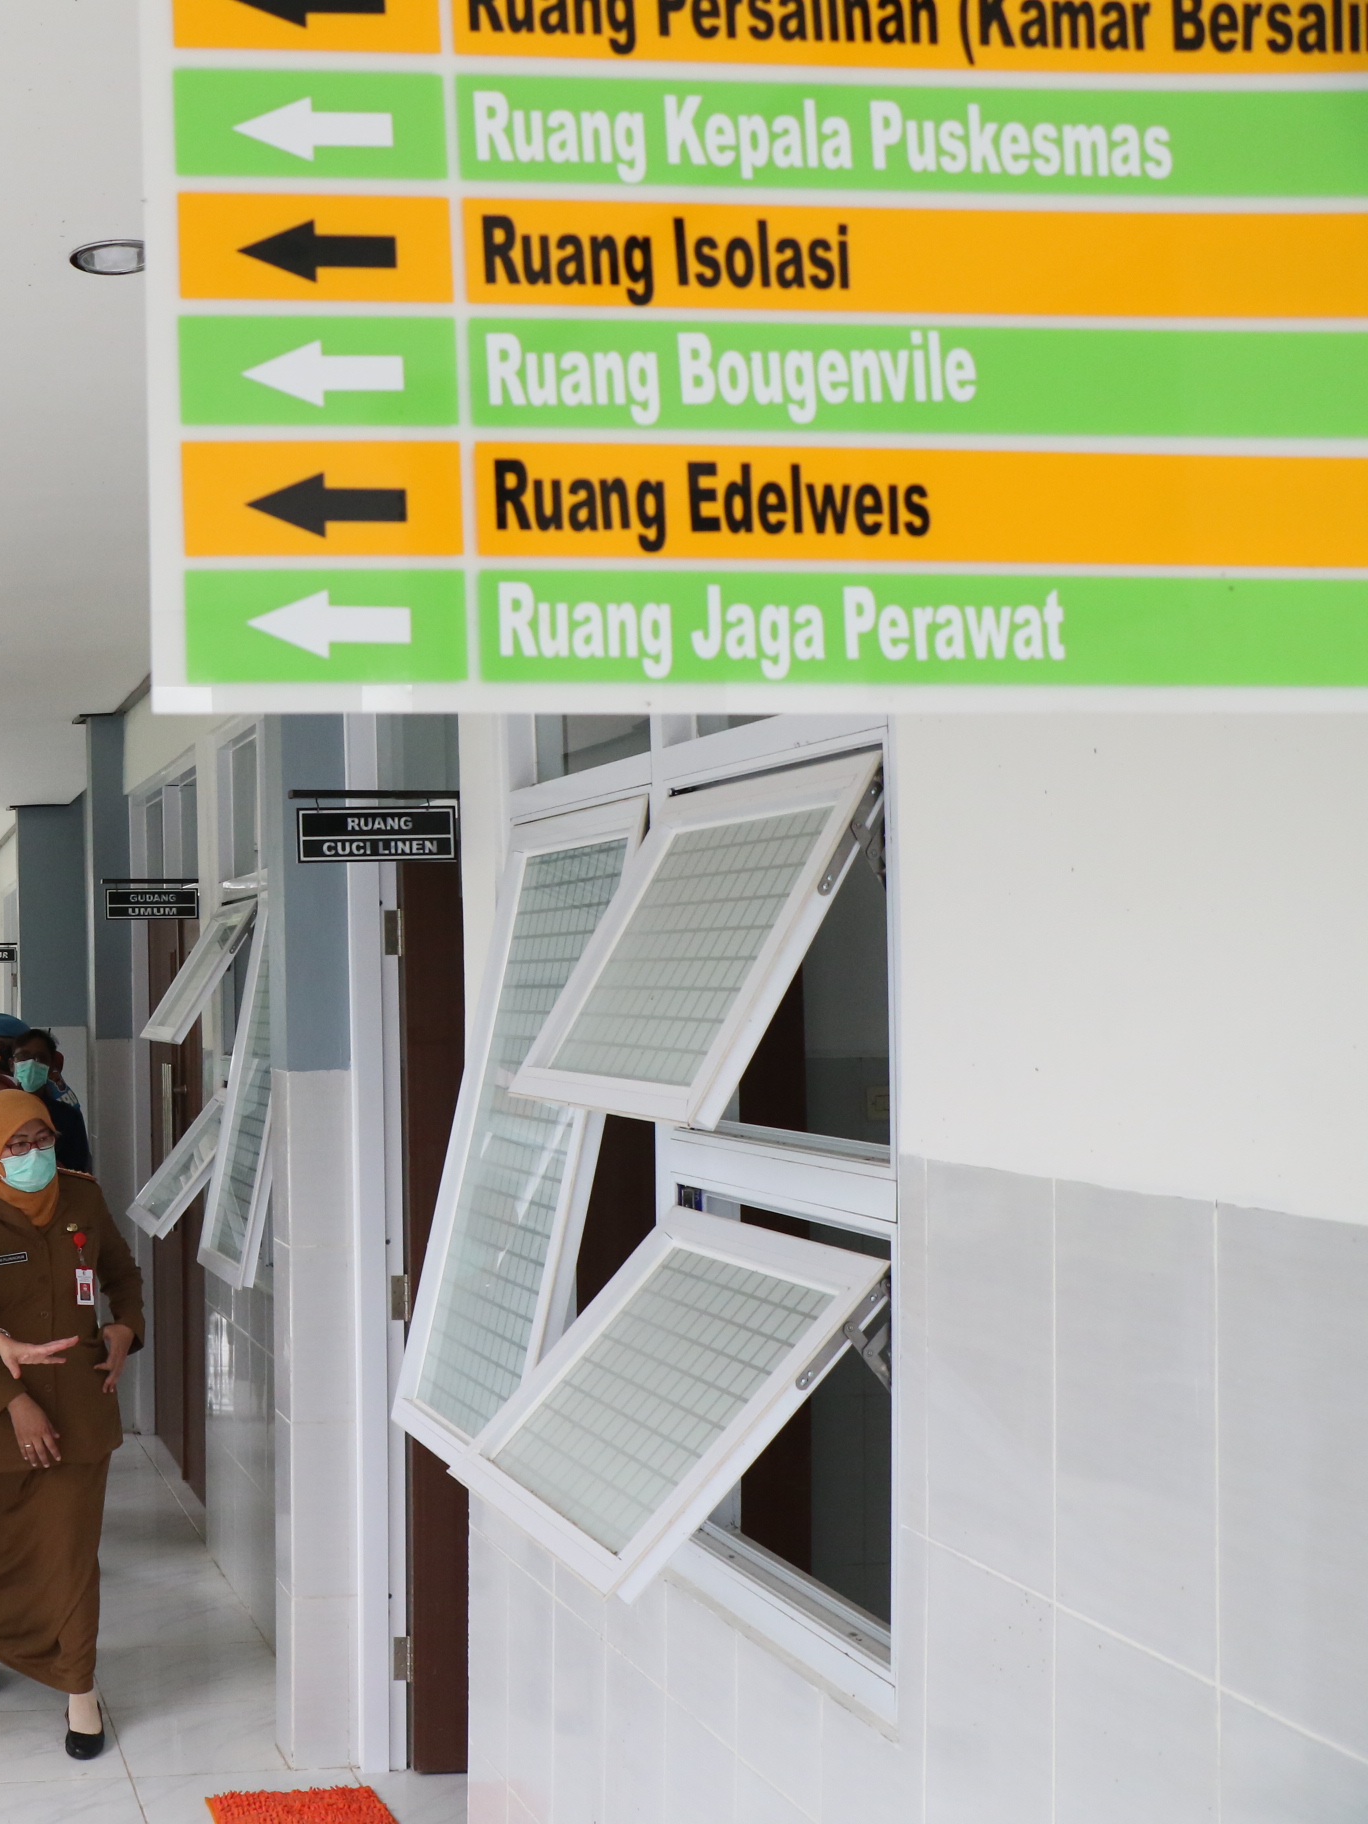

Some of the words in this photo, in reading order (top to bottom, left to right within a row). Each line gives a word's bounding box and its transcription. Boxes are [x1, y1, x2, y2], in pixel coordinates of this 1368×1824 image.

[658, 0, 938, 45] Persalinan
[960, 0, 1149, 66] (Kamar
[1173, 0, 1368, 54] Bersali
[472, 91, 646, 182] Ruang
[664, 94, 853, 180] Kepala
[870, 100, 1173, 179] Puskesmas
[482, 214, 654, 306] Ruang
[673, 217, 850, 290] Isolasi
[485, 333, 660, 425] Ruang
[677, 331, 977, 424] Bougenvile
[494, 459, 666, 552] Ruang
[687, 461, 930, 536] Edelweis
[498, 581, 672, 679] Ruang
[691, 584, 824, 680] Jaga
[843, 586, 1065, 661] Perawat
[322, 841, 371, 855] CUCI
[378, 840, 438, 855] LINEN
[347, 817, 413, 831] RUANG
[128, 907, 178, 916] UMUM
[129, 894, 177, 902] GUDANG
